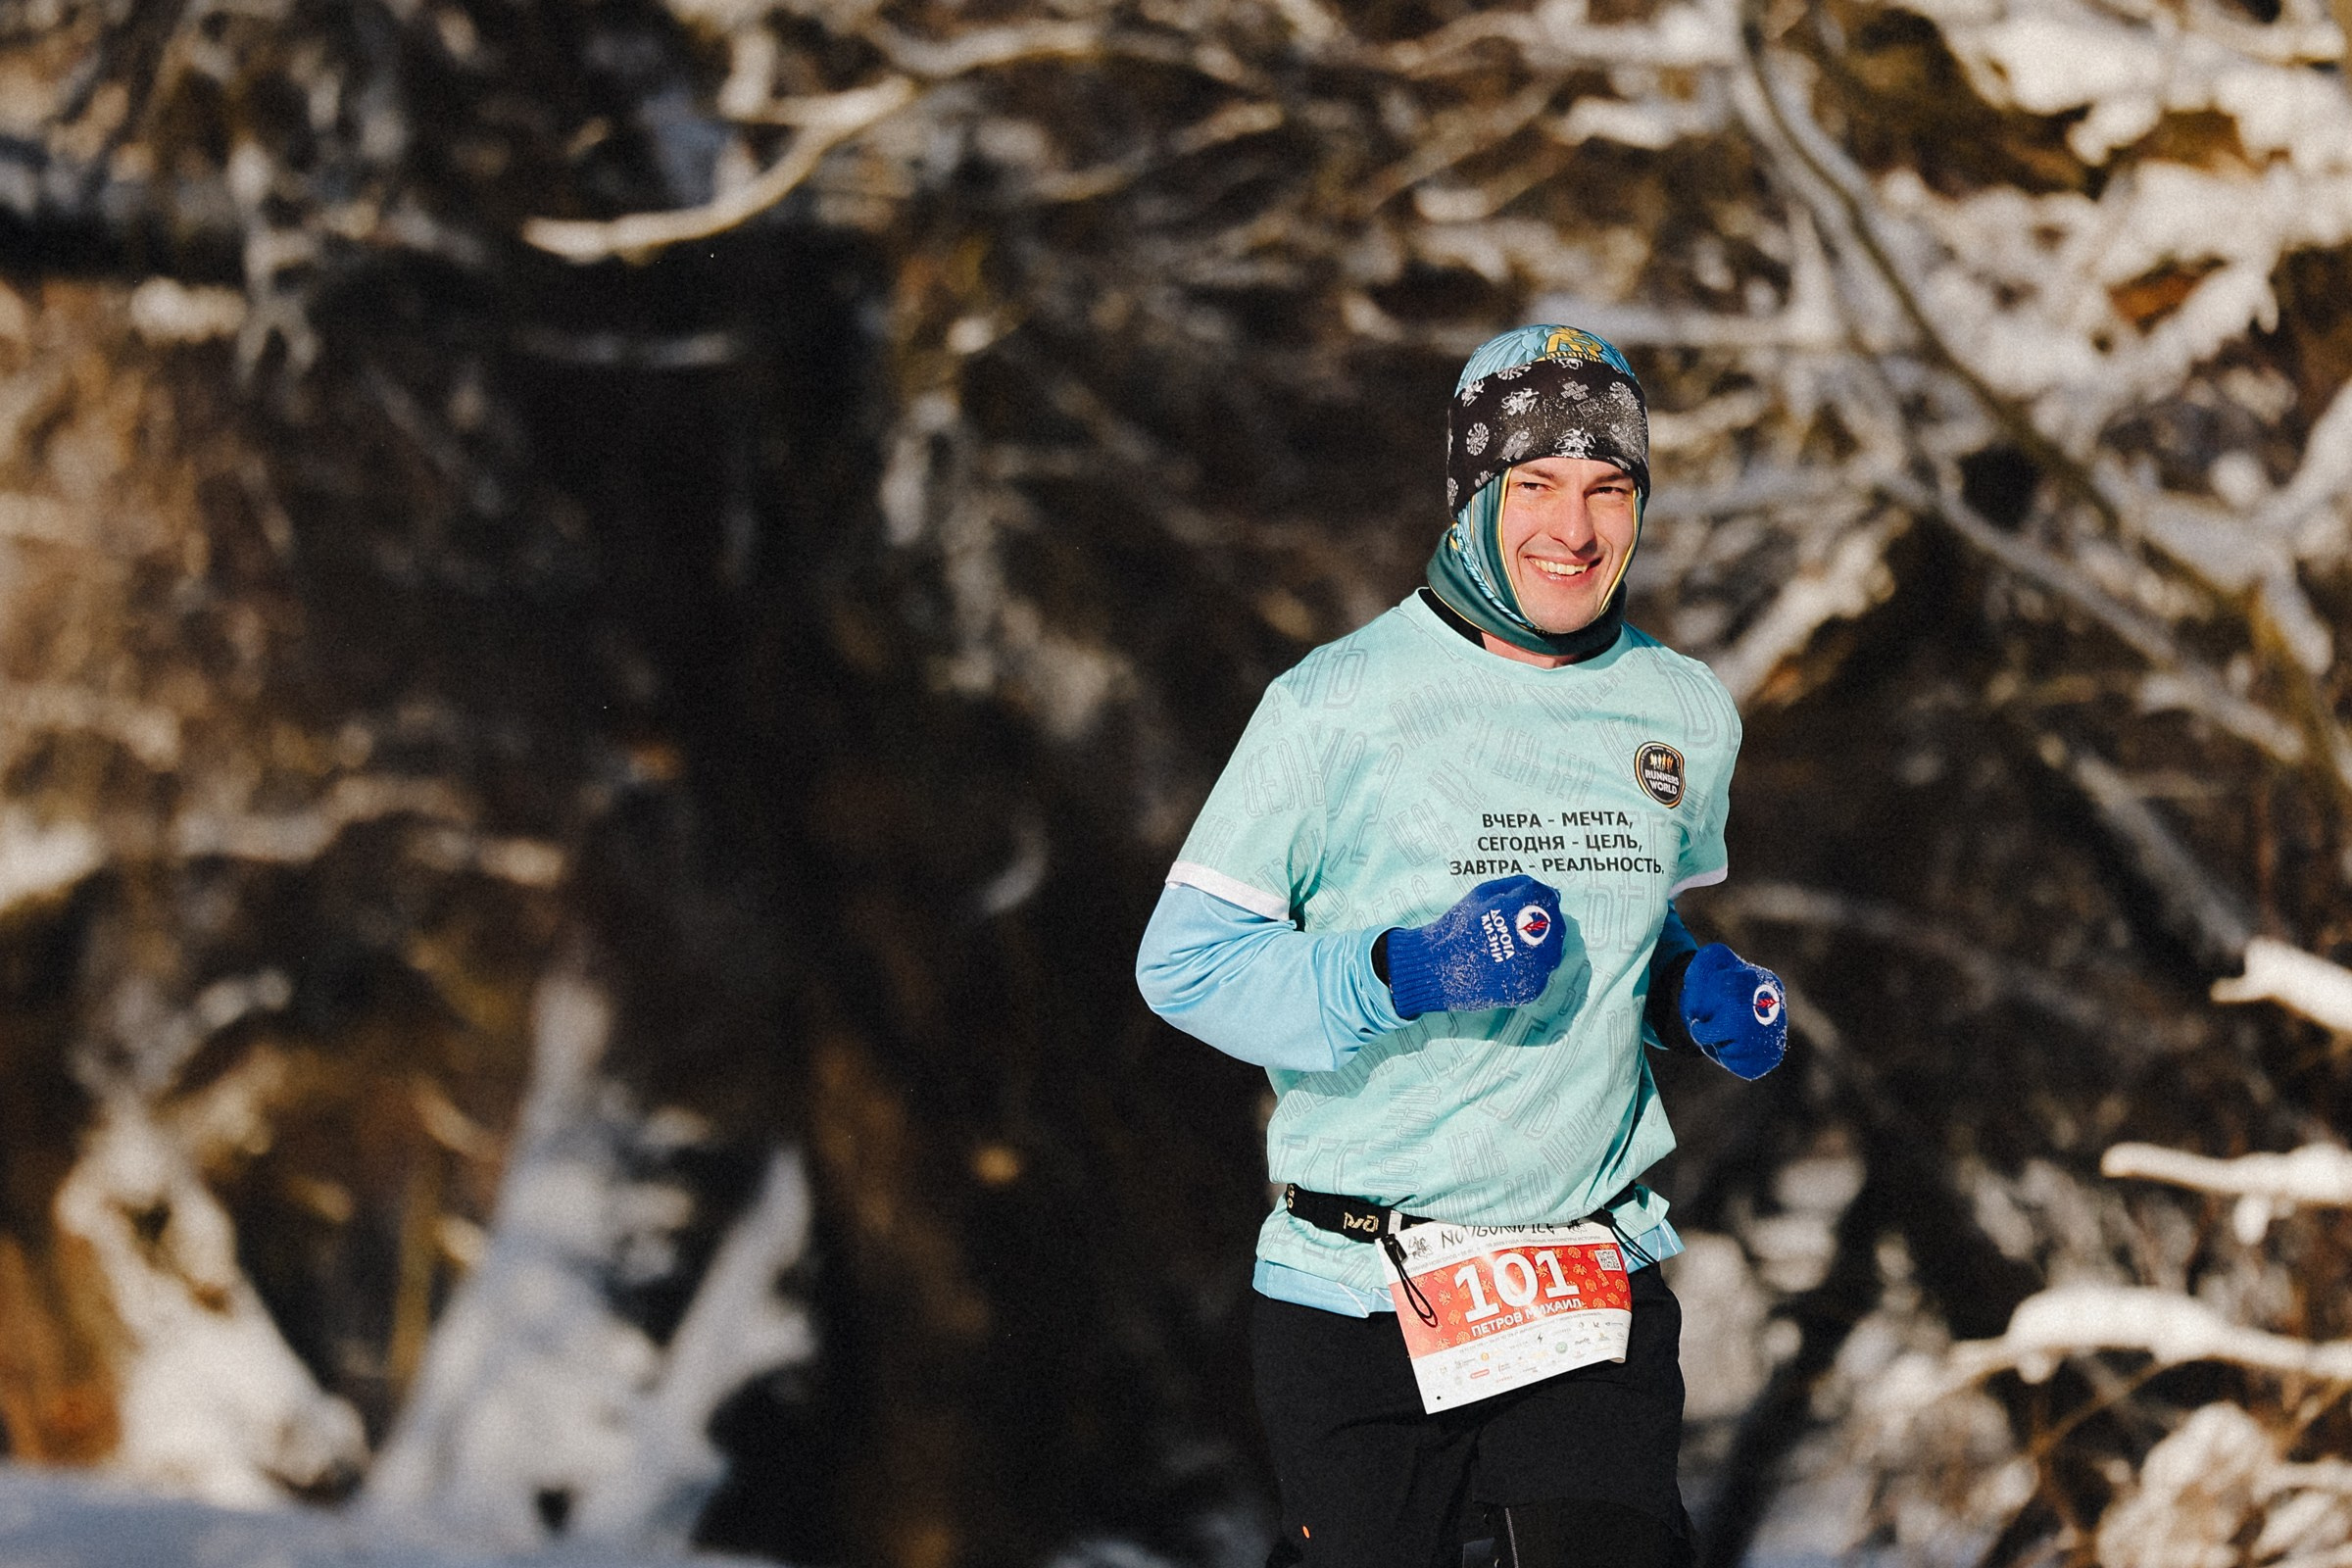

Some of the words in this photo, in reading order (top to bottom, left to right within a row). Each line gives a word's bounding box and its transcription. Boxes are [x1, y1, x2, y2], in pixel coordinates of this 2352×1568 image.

[1644, 768, 1680, 787] RUNNERS
[1648, 779, 1678, 795] WORLD
[1482, 813, 1543, 828] ВЧЕРА
[1561, 811, 1634, 829] МЕЧТА,
[1477, 835, 1565, 854] СЕГОДНЯ
[1586, 834, 1642, 853] ЦЕЛЬ,
[1449, 858, 1524, 875] ЗАВТРА
[1542, 857, 1665, 875] РЕАЛЬНОСТЬ.
[1480, 911, 1504, 963] ЖИЗНИ
[1490, 908, 1516, 960] ДОРОГА
[1453, 1250, 1581, 1323] 101
[1471, 1312, 1524, 1337] ПЕТРОВ
